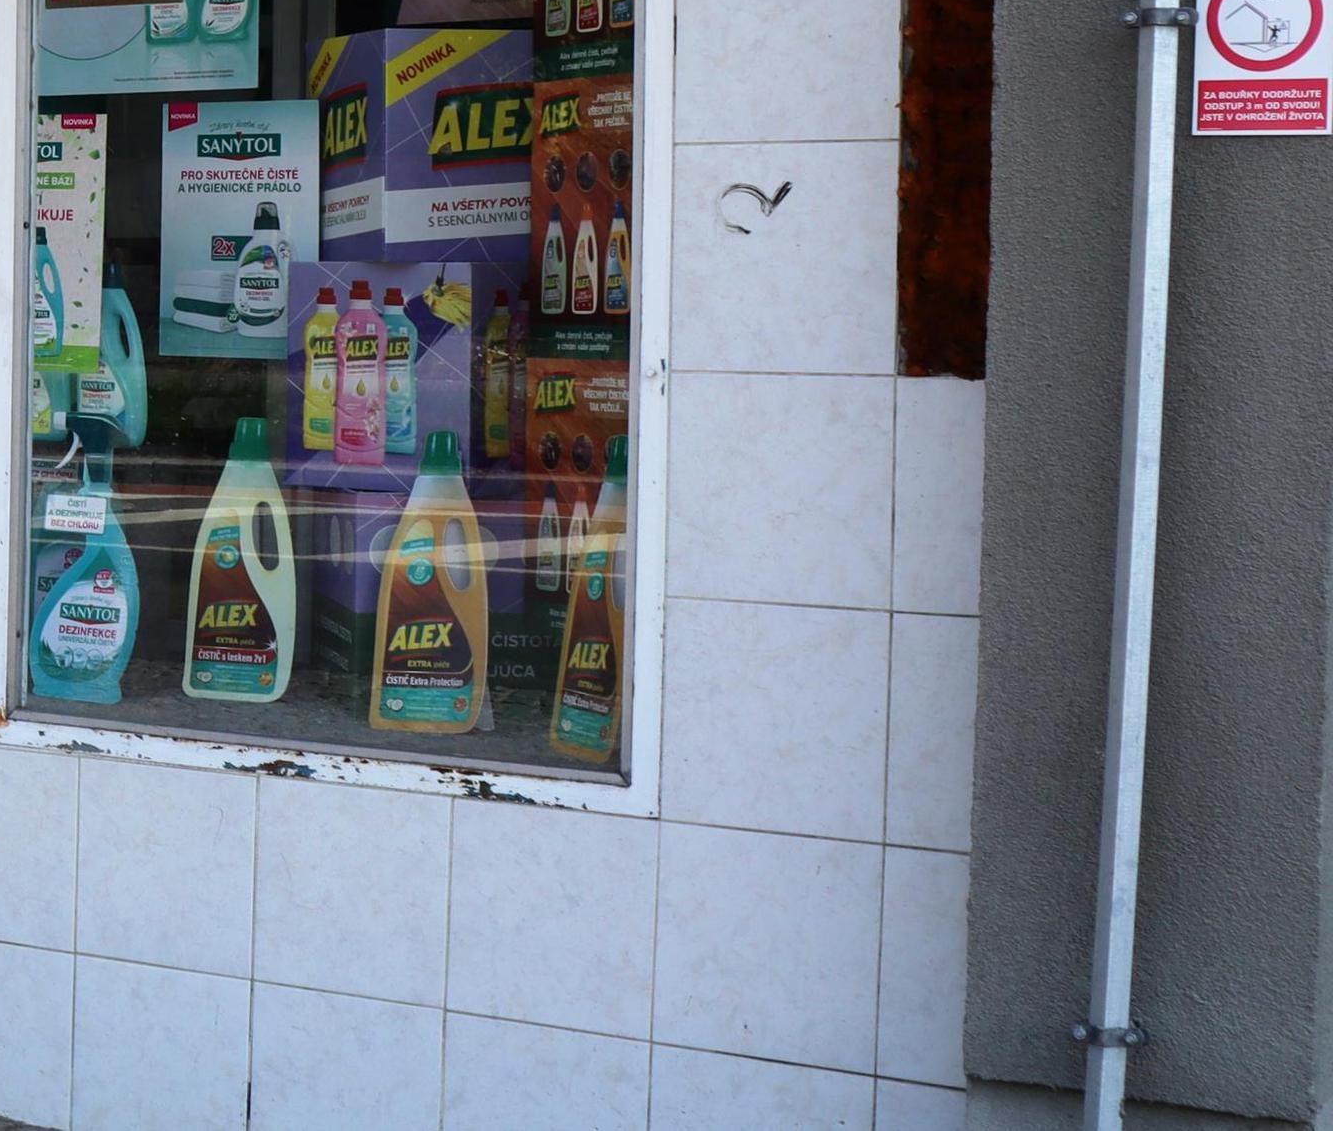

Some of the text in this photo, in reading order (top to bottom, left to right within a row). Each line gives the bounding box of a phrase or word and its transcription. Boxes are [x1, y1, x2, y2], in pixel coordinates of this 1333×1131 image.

[396, 43, 456, 85] NOVINKA
[1204, 89, 1322, 99] ZA BOUŘKY DODRŽUJTE
[1204, 102, 1244, 110] ODSTUP
[1265, 101, 1280, 109] OD
[1282, 101, 1320, 109] SVODU!
[63, 118, 93, 126] NOVINKA
[540, 98, 581, 135] ALEX
[1200, 111, 1324, 121] JSTE V OHROŽENÍ ŽIVOTA
[323, 97, 368, 159] ALEX
[201, 137, 278, 153] SANYTOL
[51, 173, 73, 186] BÁZI
[181, 170, 203, 181] PRO
[268, 166, 299, 180] ČISTÉ
[178, 180, 301, 194] A HYGIENICKÉ PRÁDLO
[429, 211, 517, 227] S ESENCIÁLNYMI
[213, 237, 235, 256] 2x
[241, 279, 277, 289] SANYTOL
[346, 338, 379, 357] ALEX
[82, 381, 114, 391] SANYTOL
[534, 379, 577, 411] ALEX
[67, 498, 87, 508] ČISTÍ
[56, 508, 103, 520] DEZINFIKUJE
[51, 518, 99, 530] BEZ CHLÓRU
[61, 606, 119, 622] SANYTOL
[198, 604, 258, 629] ALEX
[59, 625, 117, 639] DEZINFEKCE
[389, 622, 454, 651] ALEX
[216, 636, 238, 644] EXTRA
[198, 648, 221, 660] ČISTIČ
[227, 652, 253, 663] leskem
[254, 654, 267, 663] 2v1
[568, 642, 610, 670] ALEX
[408, 659, 431, 668] EXTRA
[386, 673, 464, 688] ČISTIČ Extra Protection
